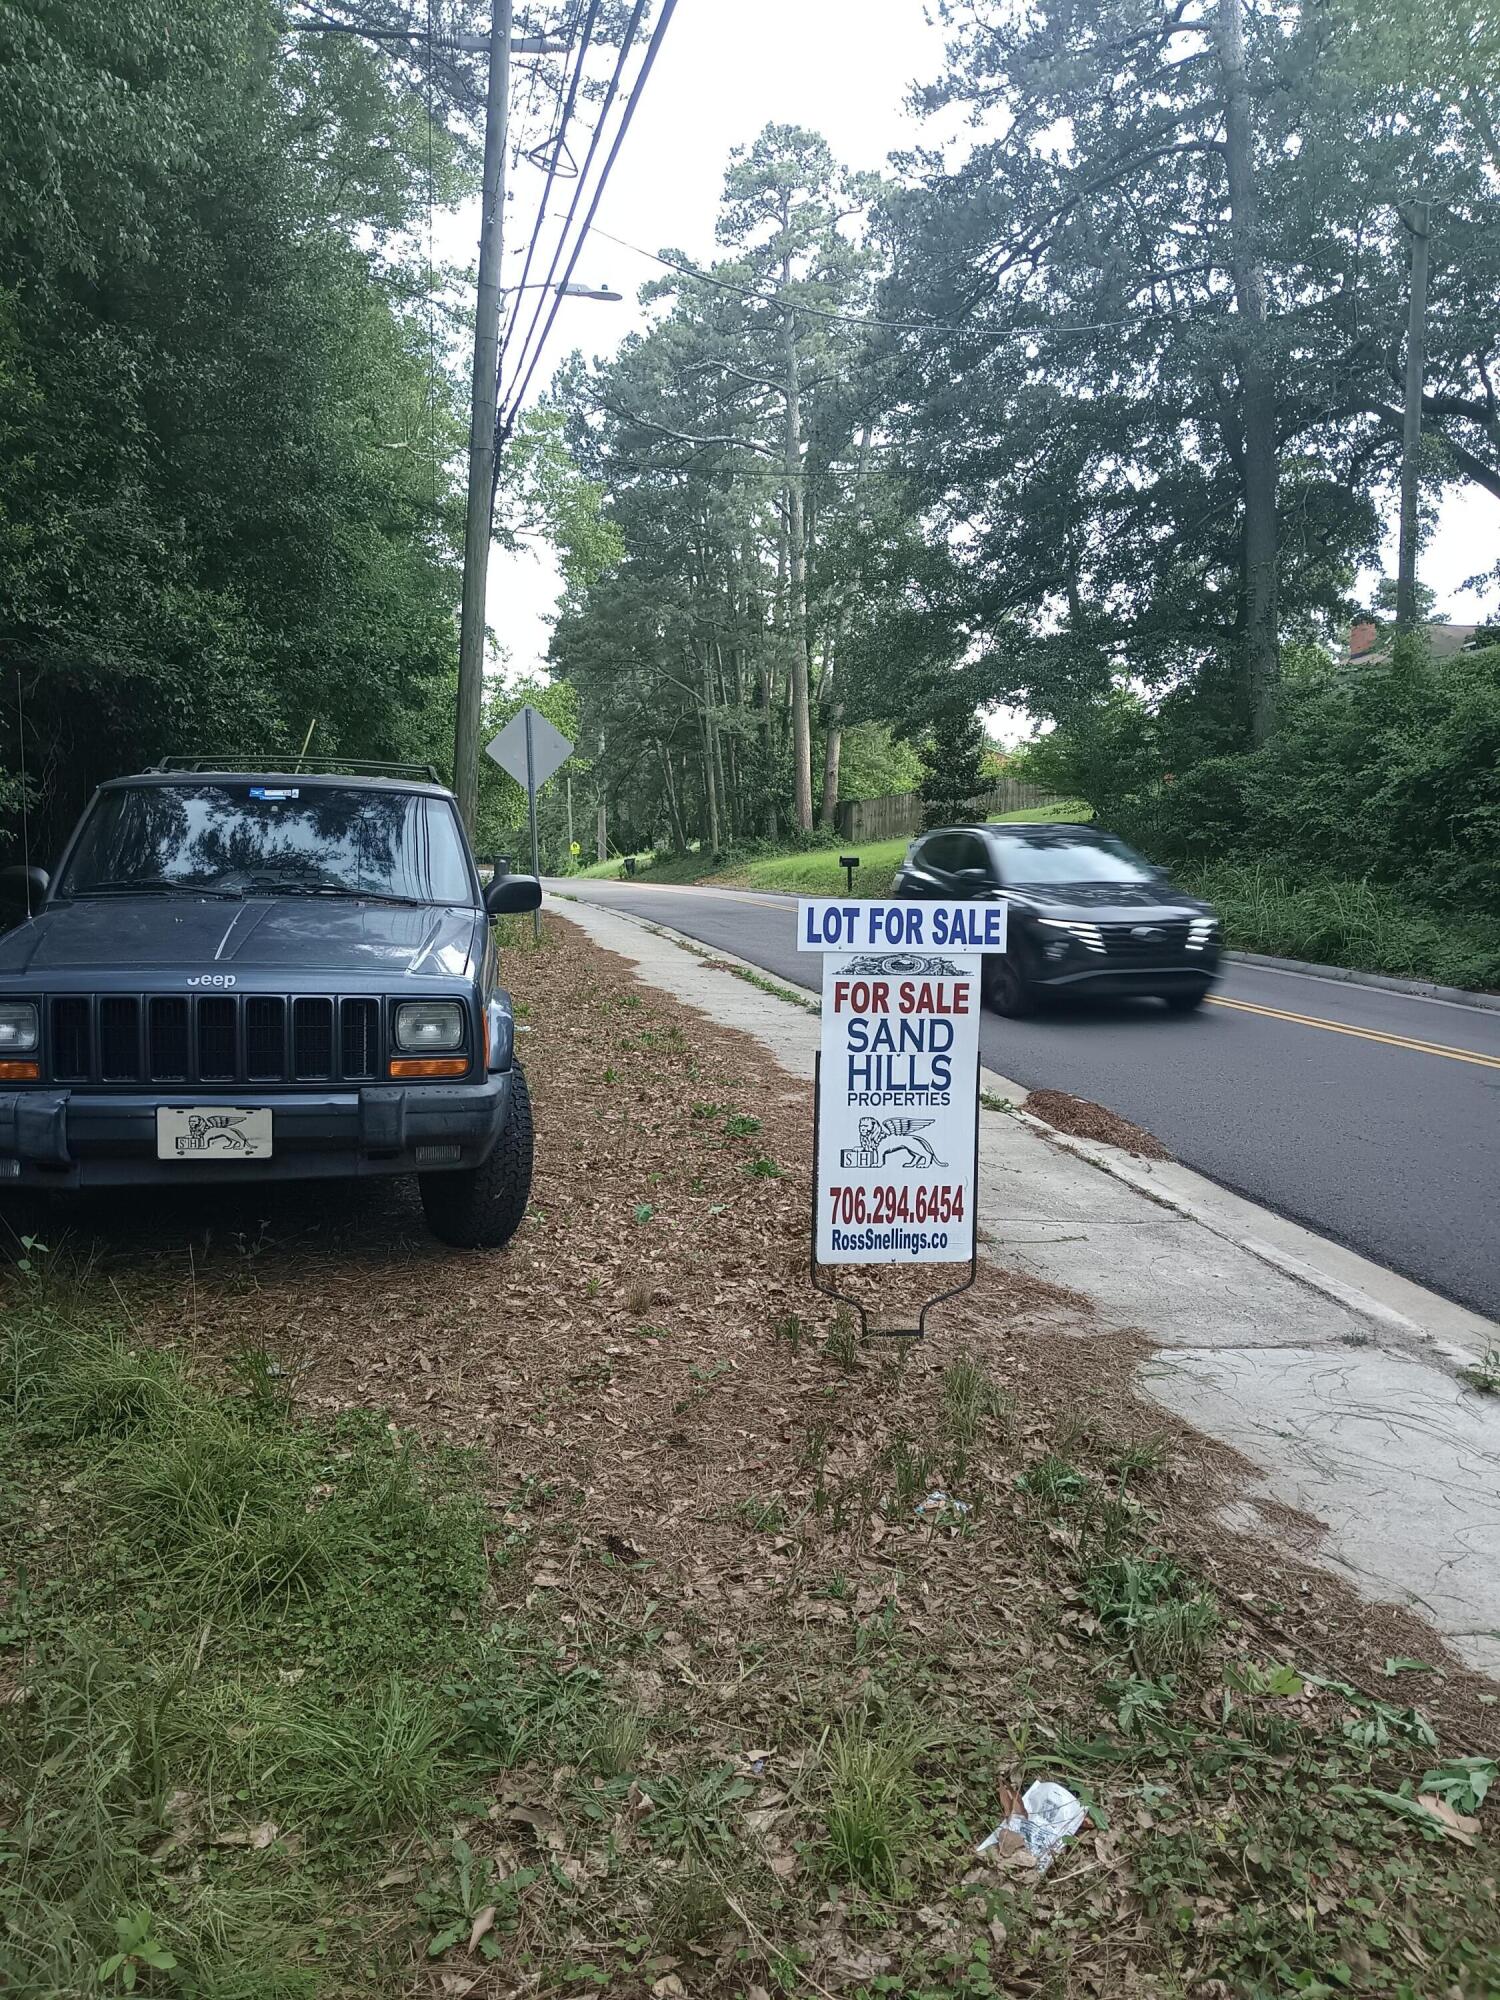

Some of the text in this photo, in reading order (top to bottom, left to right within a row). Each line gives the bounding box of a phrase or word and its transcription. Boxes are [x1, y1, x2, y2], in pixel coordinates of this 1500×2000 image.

[806, 906, 1001, 945] LOT FOR SALE
[187, 974, 237, 989] Jeep
[834, 981, 970, 1014] FOR SALE
[846, 1017, 954, 1053] SAND
[847, 1054, 952, 1091] HILLS
[847, 1092, 951, 1106] PROPERTIES
[829, 1185, 964, 1224] 706.294.6454
[831, 1228, 948, 1254] RossSnellings.co
